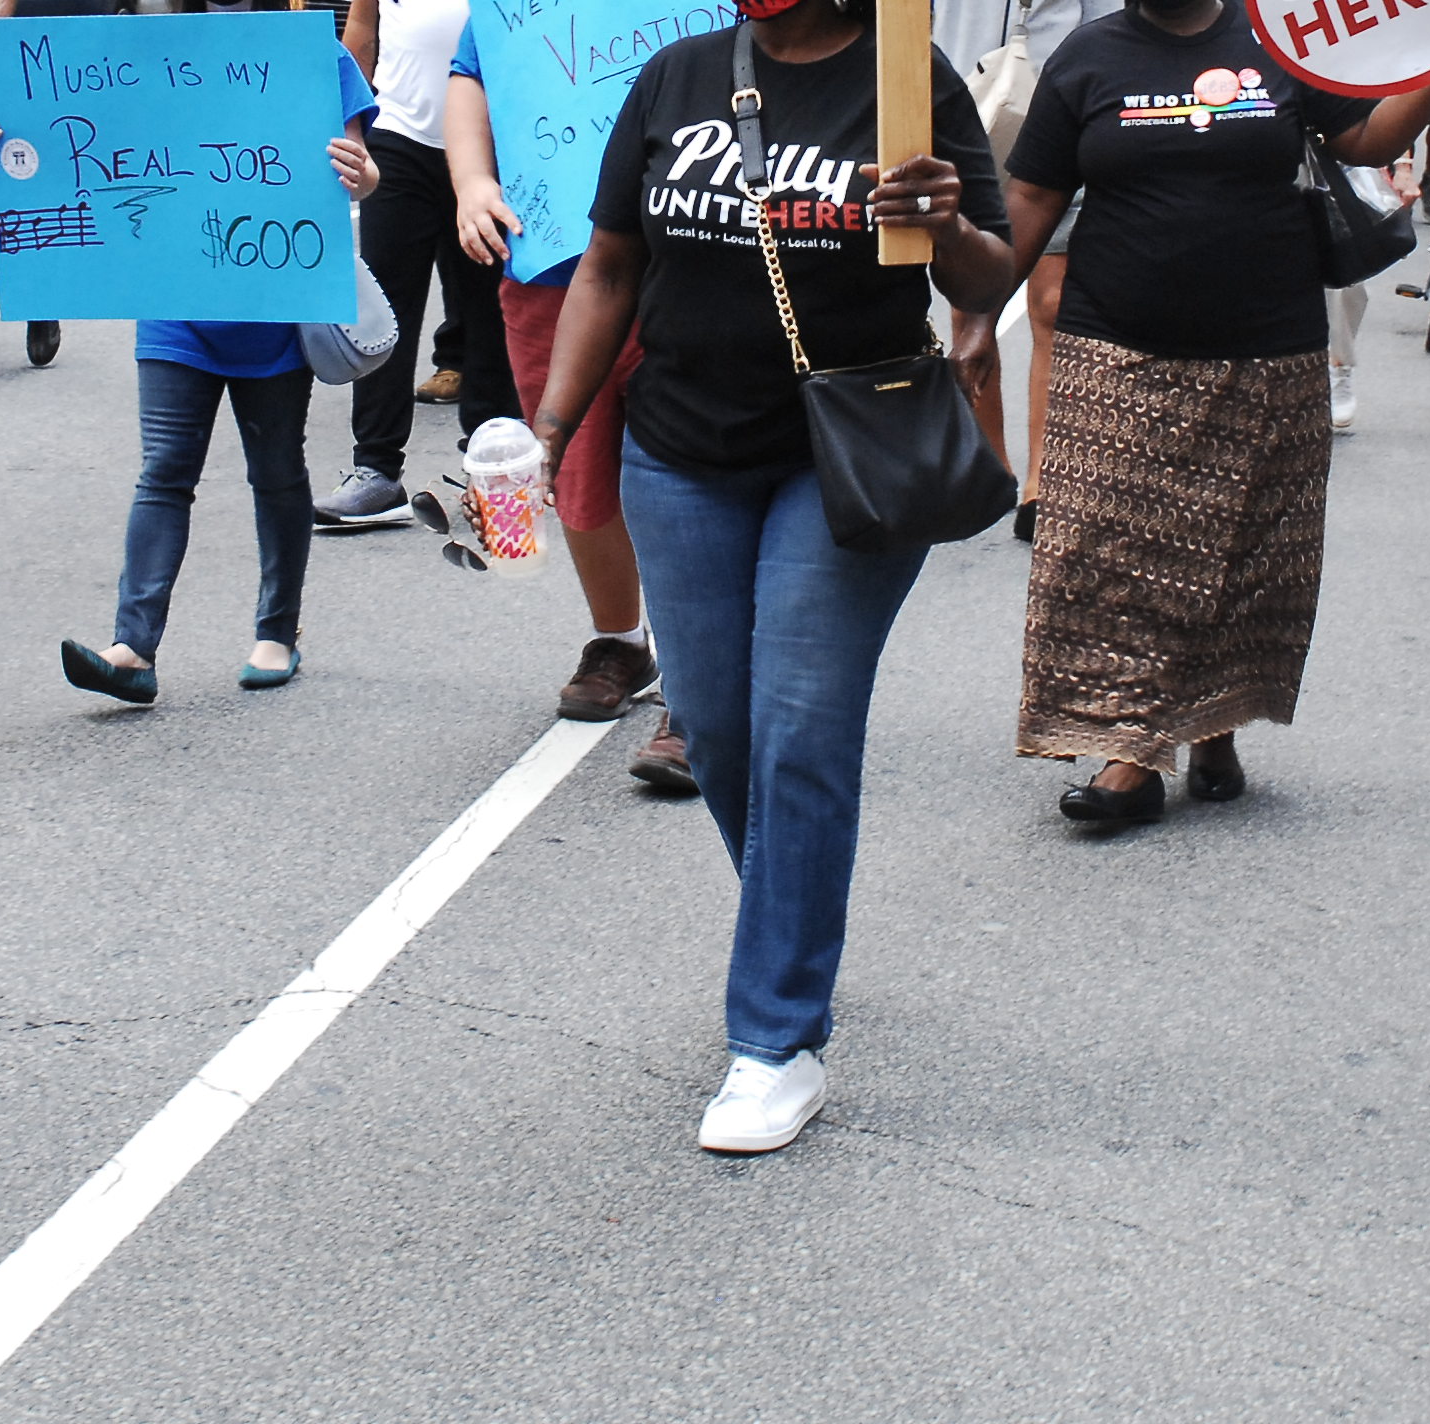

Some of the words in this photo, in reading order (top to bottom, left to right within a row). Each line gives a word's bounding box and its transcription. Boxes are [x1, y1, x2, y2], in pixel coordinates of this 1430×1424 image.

[163, 56, 203, 89] is
[1123, 94, 1150, 108] WE
[1154, 94, 1179, 108] DO
[1235, 88, 1270, 101] ORK
[49, 115, 195, 188] REAL
[199, 141, 292, 186] JOB
[666, 119, 856, 209] Philly
[647, 186, 762, 228] UNITE
[201, 208, 324, 270] $600
[666, 226, 695, 238] Local
[723, 233, 756, 246] Local
[788, 237, 818, 248] Local
[820, 238, 842, 250] 634
